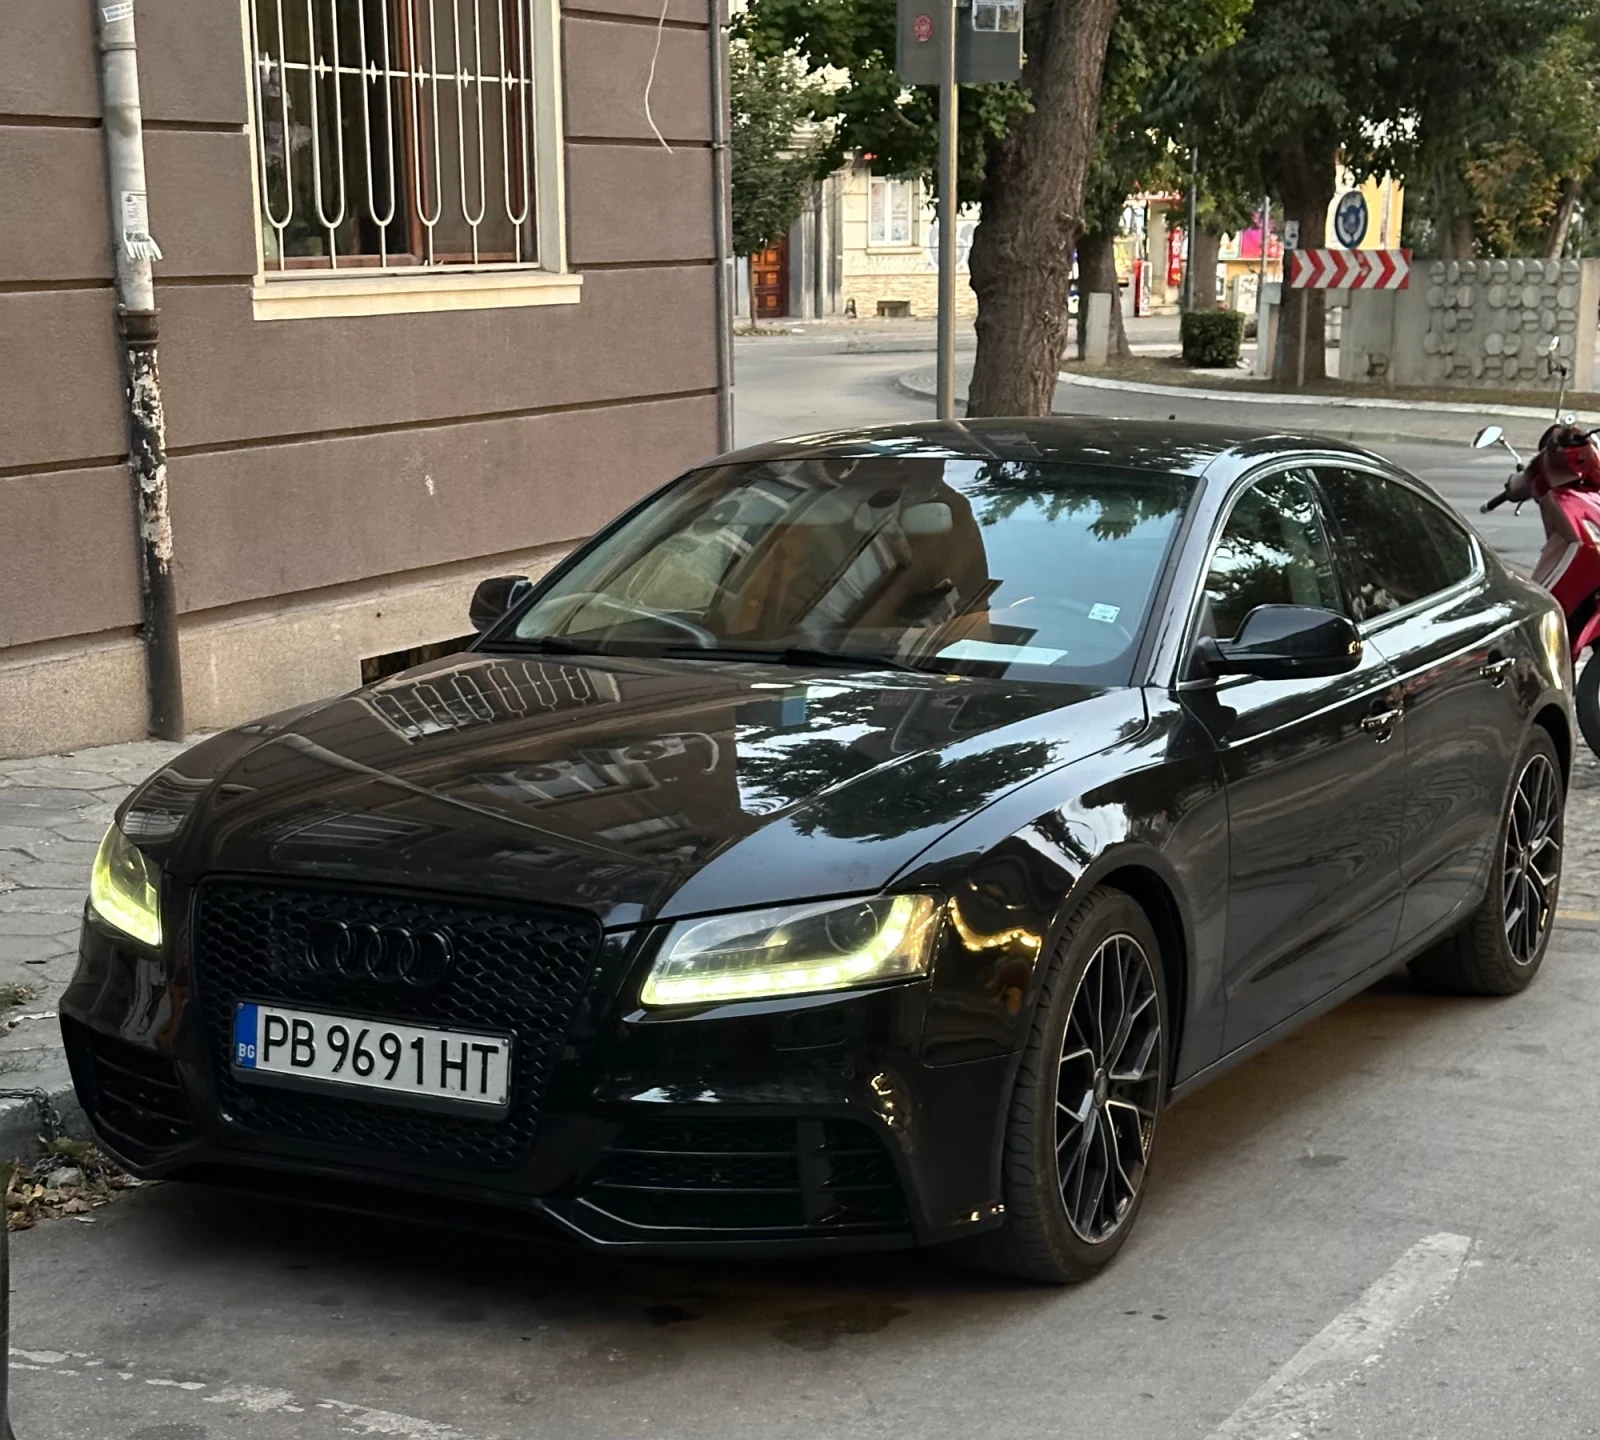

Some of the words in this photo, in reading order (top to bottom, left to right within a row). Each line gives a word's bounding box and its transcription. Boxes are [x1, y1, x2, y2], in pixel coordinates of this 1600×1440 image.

[238, 1042, 256, 1059] BG
[263, 1014, 316, 1068] PB
[326, 1024, 426, 1085] 9691
[440, 1038, 500, 1094] HT
